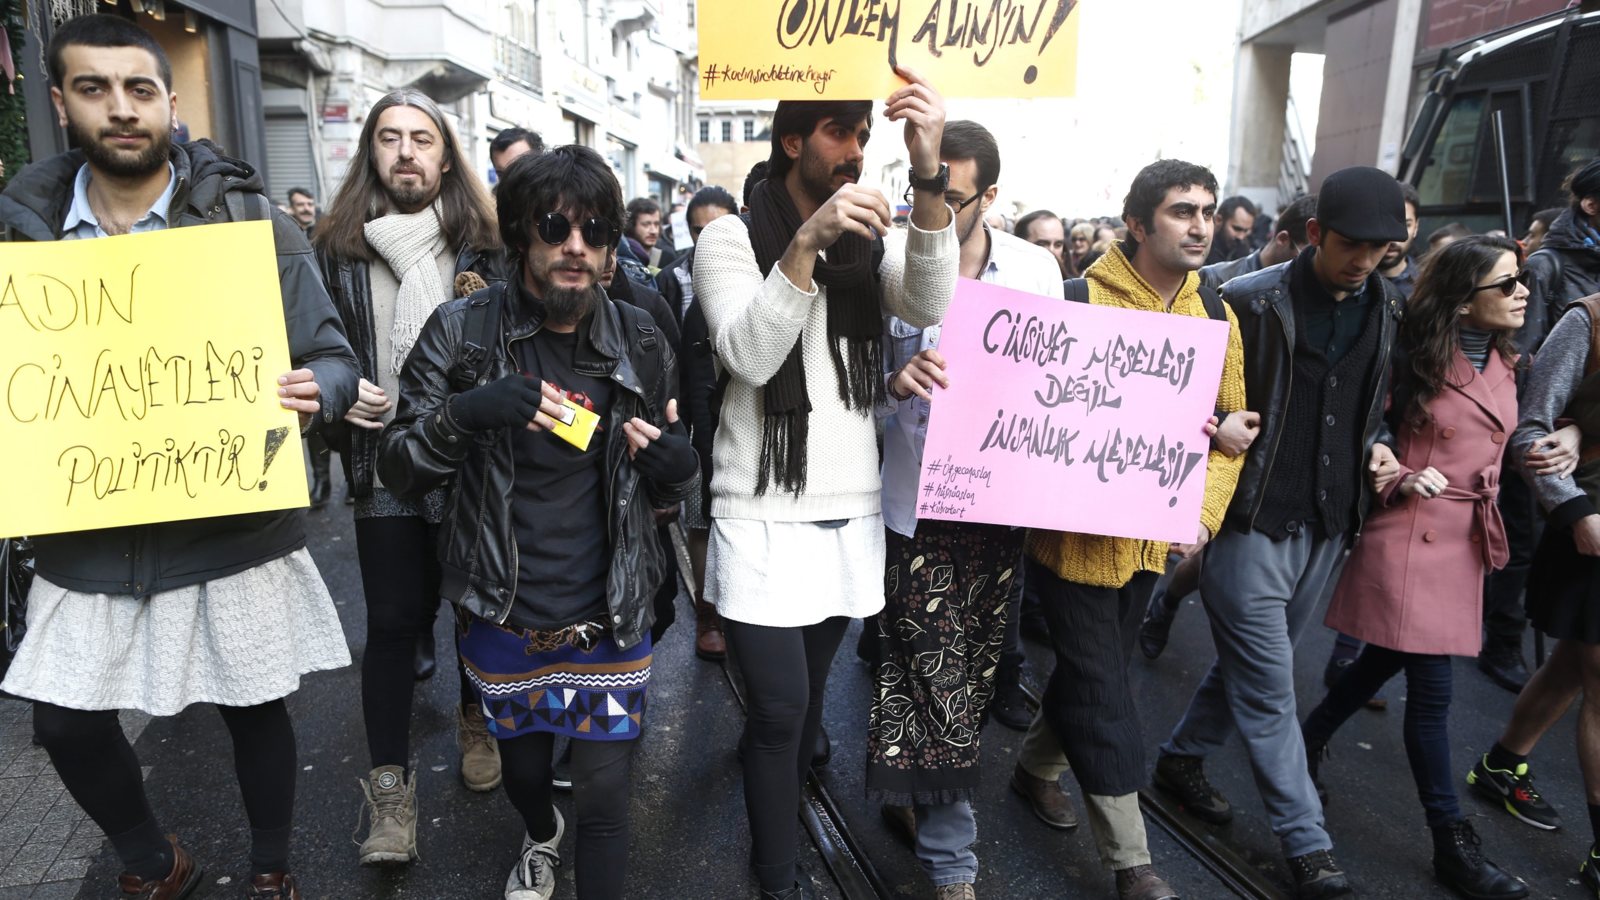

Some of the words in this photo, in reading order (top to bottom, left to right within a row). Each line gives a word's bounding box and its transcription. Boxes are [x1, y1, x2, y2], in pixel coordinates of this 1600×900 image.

[8, 340, 263, 423] CİNAYETLERİ
[983, 309, 1078, 367] CİNSİYET
[1082, 334, 1196, 394] MESELESİ
[1034, 373, 1122, 416] DEĞİL
[58, 426, 291, 506] POLİTİKTİR!
[979, 409, 1080, 466] İNSANLIK
